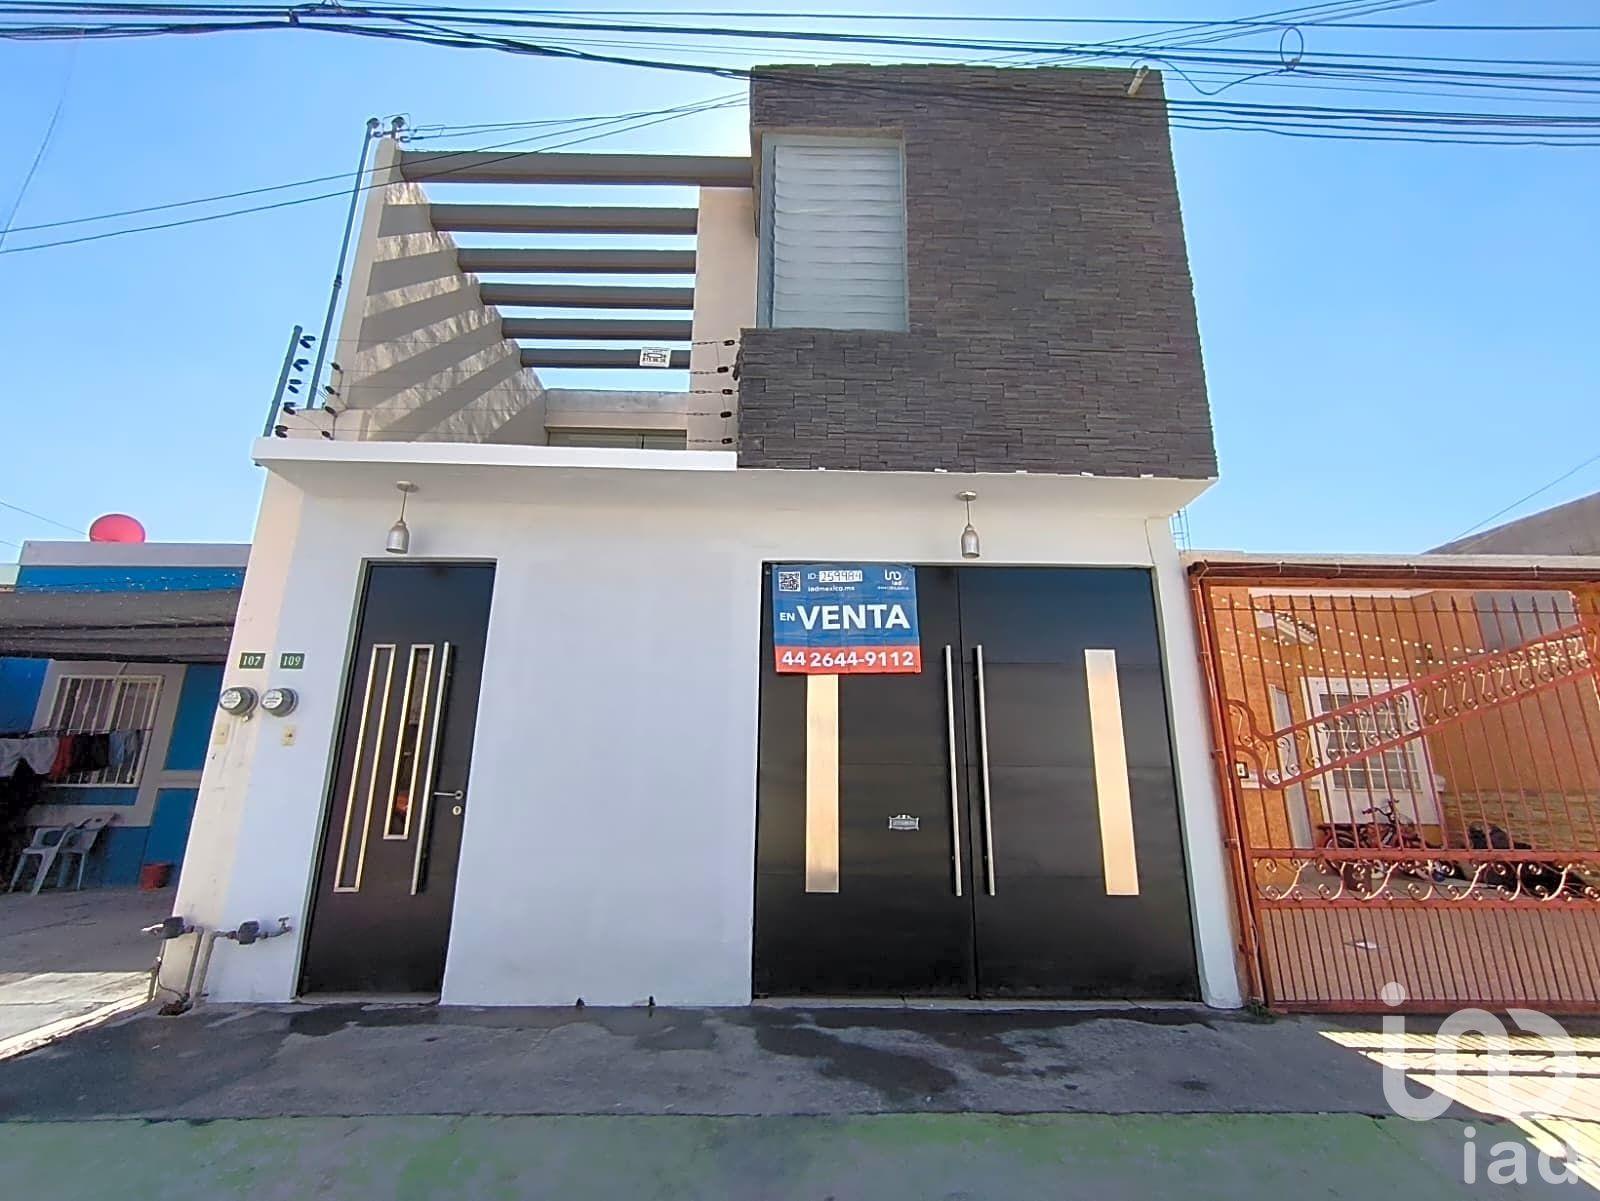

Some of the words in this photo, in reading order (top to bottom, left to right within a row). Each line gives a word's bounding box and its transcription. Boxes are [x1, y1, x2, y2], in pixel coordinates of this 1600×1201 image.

[779, 612, 795, 621] EN
[796, 604, 911, 630] VENTA
[242, 655, 261, 666] 107
[283, 655, 301, 666] 109
